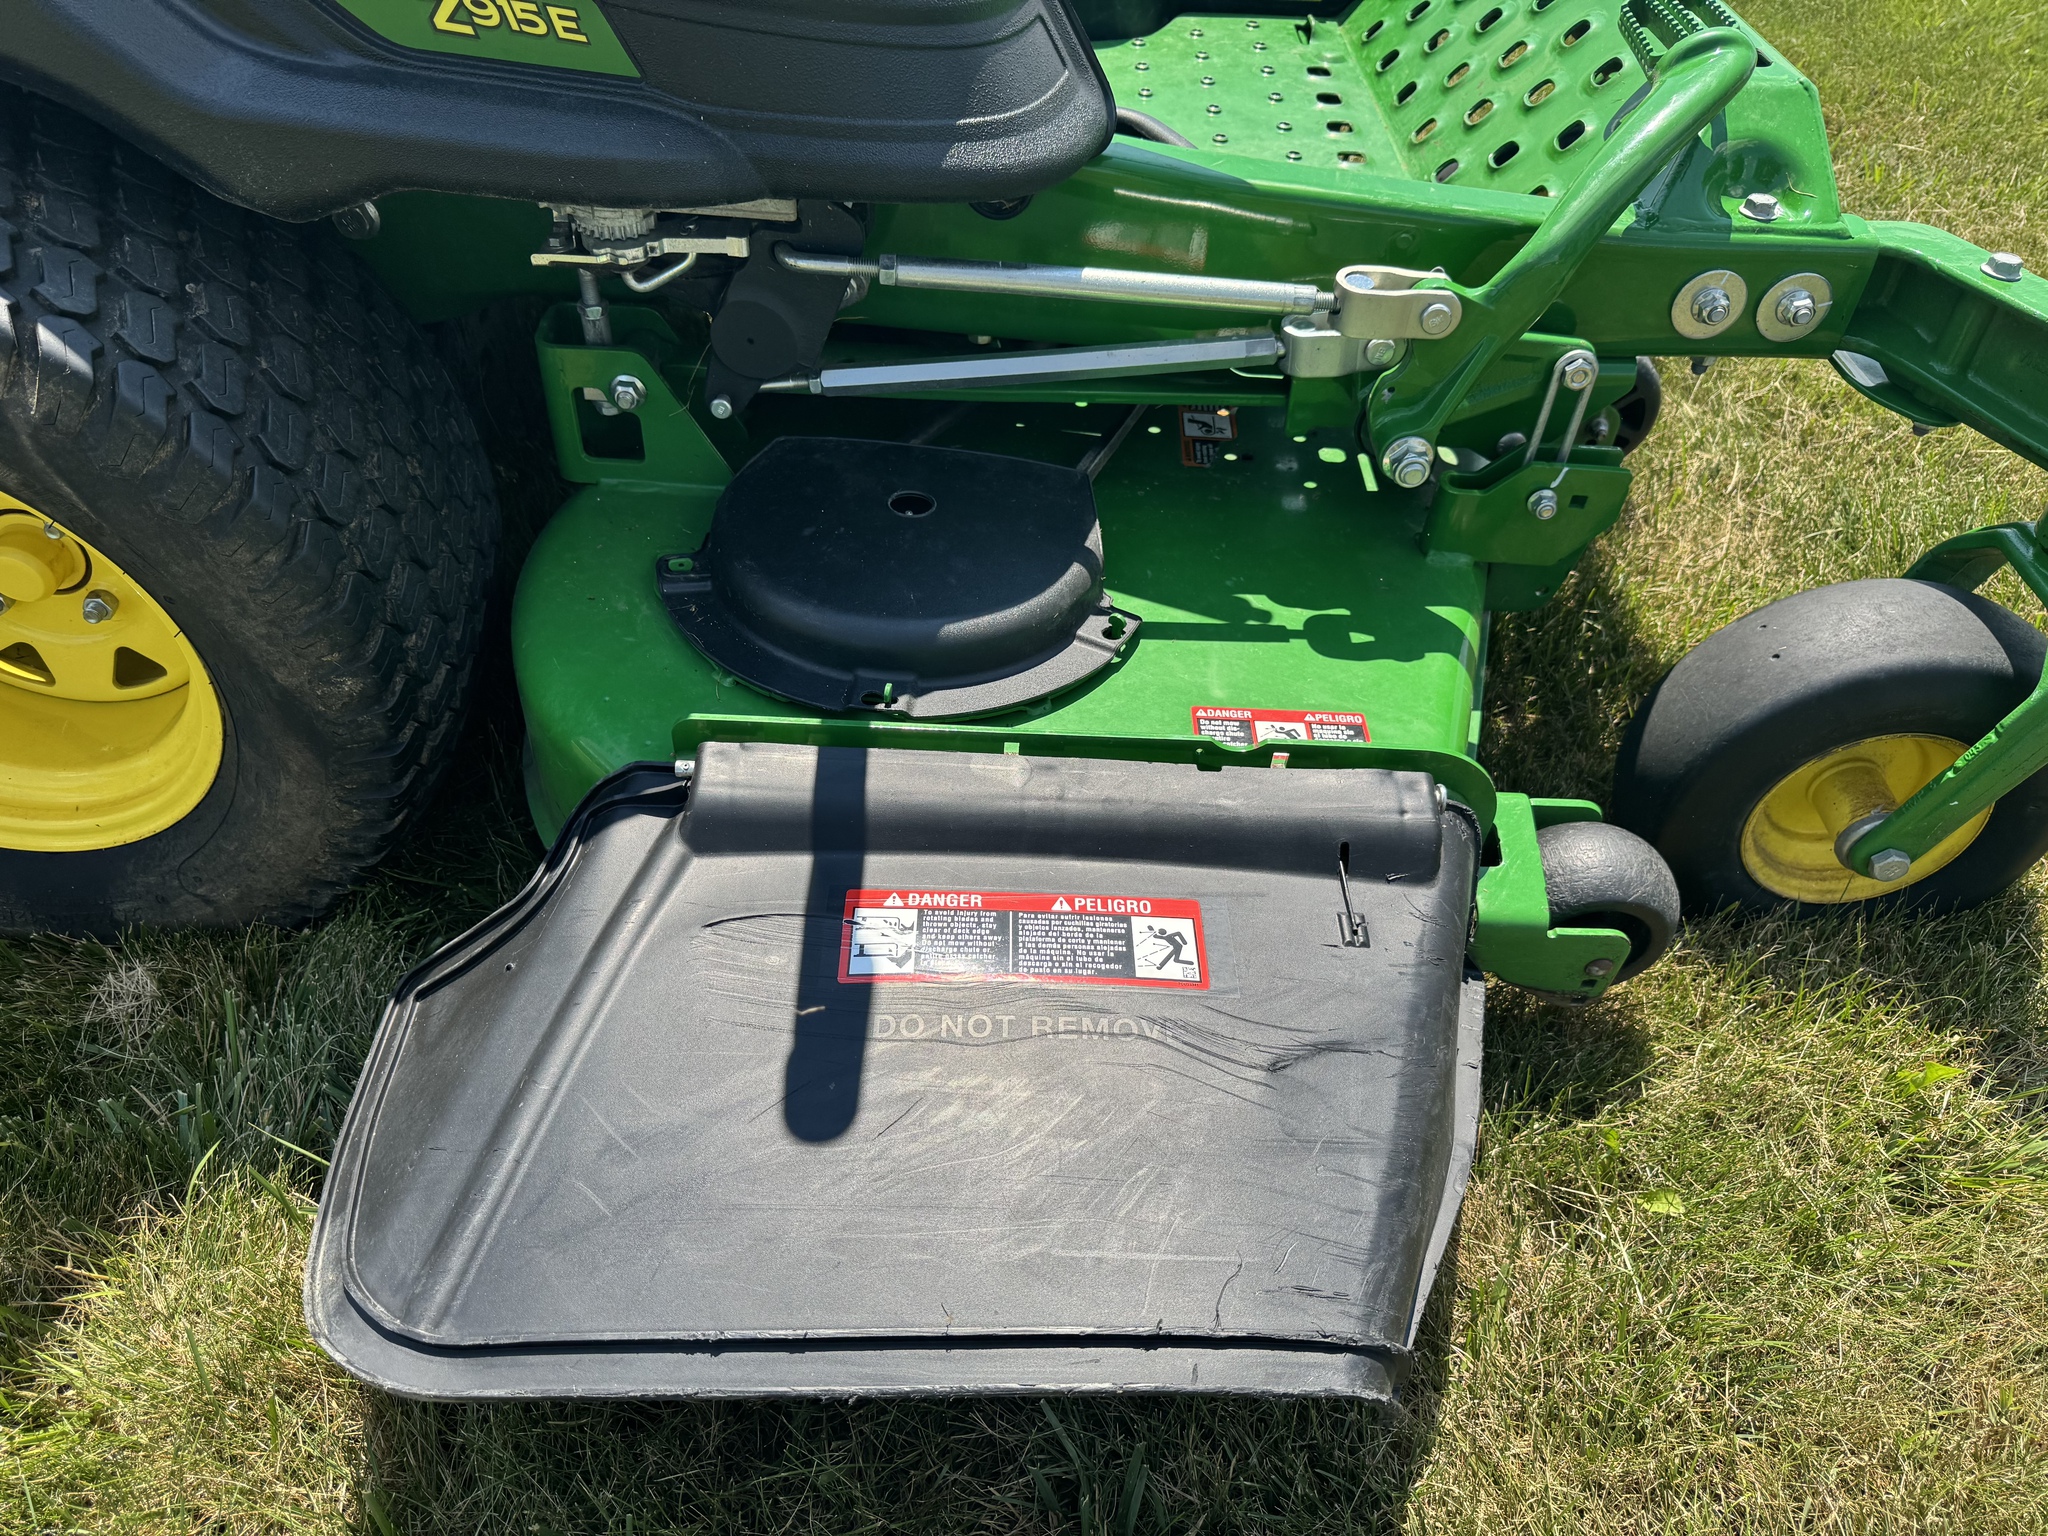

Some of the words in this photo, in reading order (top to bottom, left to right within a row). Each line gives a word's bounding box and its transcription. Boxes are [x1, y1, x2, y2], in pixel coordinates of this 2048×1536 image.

[433, 0, 588, 42] Z915E
[1207, 709, 1252, 718] DANGER
[1315, 714, 1362, 723] PELIGRO
[908, 893, 983, 908] DANGER
[1074, 897, 1151, 914] PELIGRO
[1095, 921, 1127, 929] giratorias
[1019, 960, 1052, 968] descarga
[1085, 962, 1122, 970] recogedor
[872, 1013, 925, 1038] DO
[939, 1013, 1016, 1038] NOT
